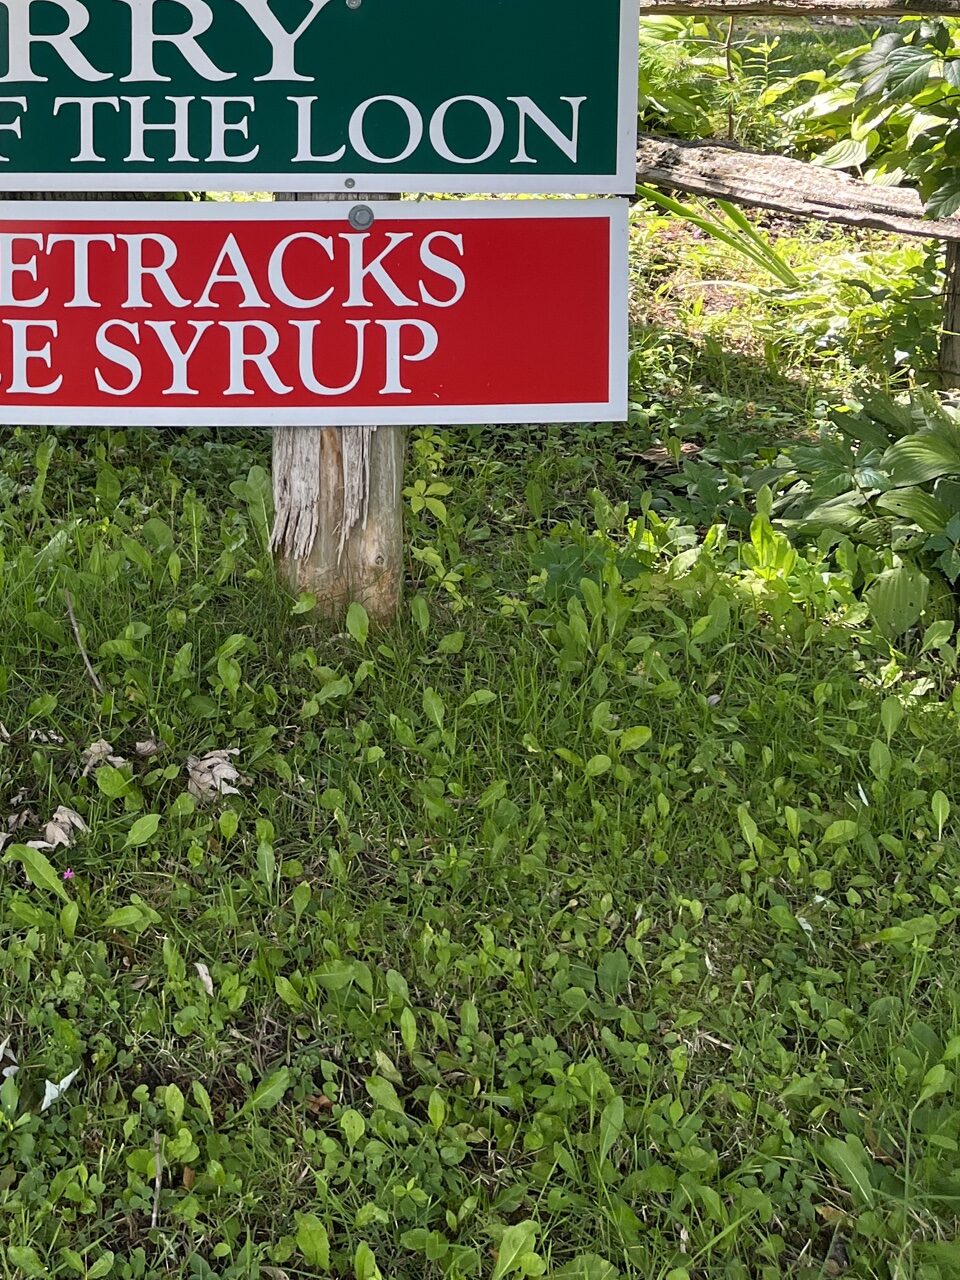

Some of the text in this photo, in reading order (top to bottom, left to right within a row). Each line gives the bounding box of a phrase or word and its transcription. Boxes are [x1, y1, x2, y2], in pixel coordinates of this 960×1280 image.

[52, 95, 260, 163] THE
[285, 94, 588, 164] LOON
[94, 318, 439, 396] SYRUP
